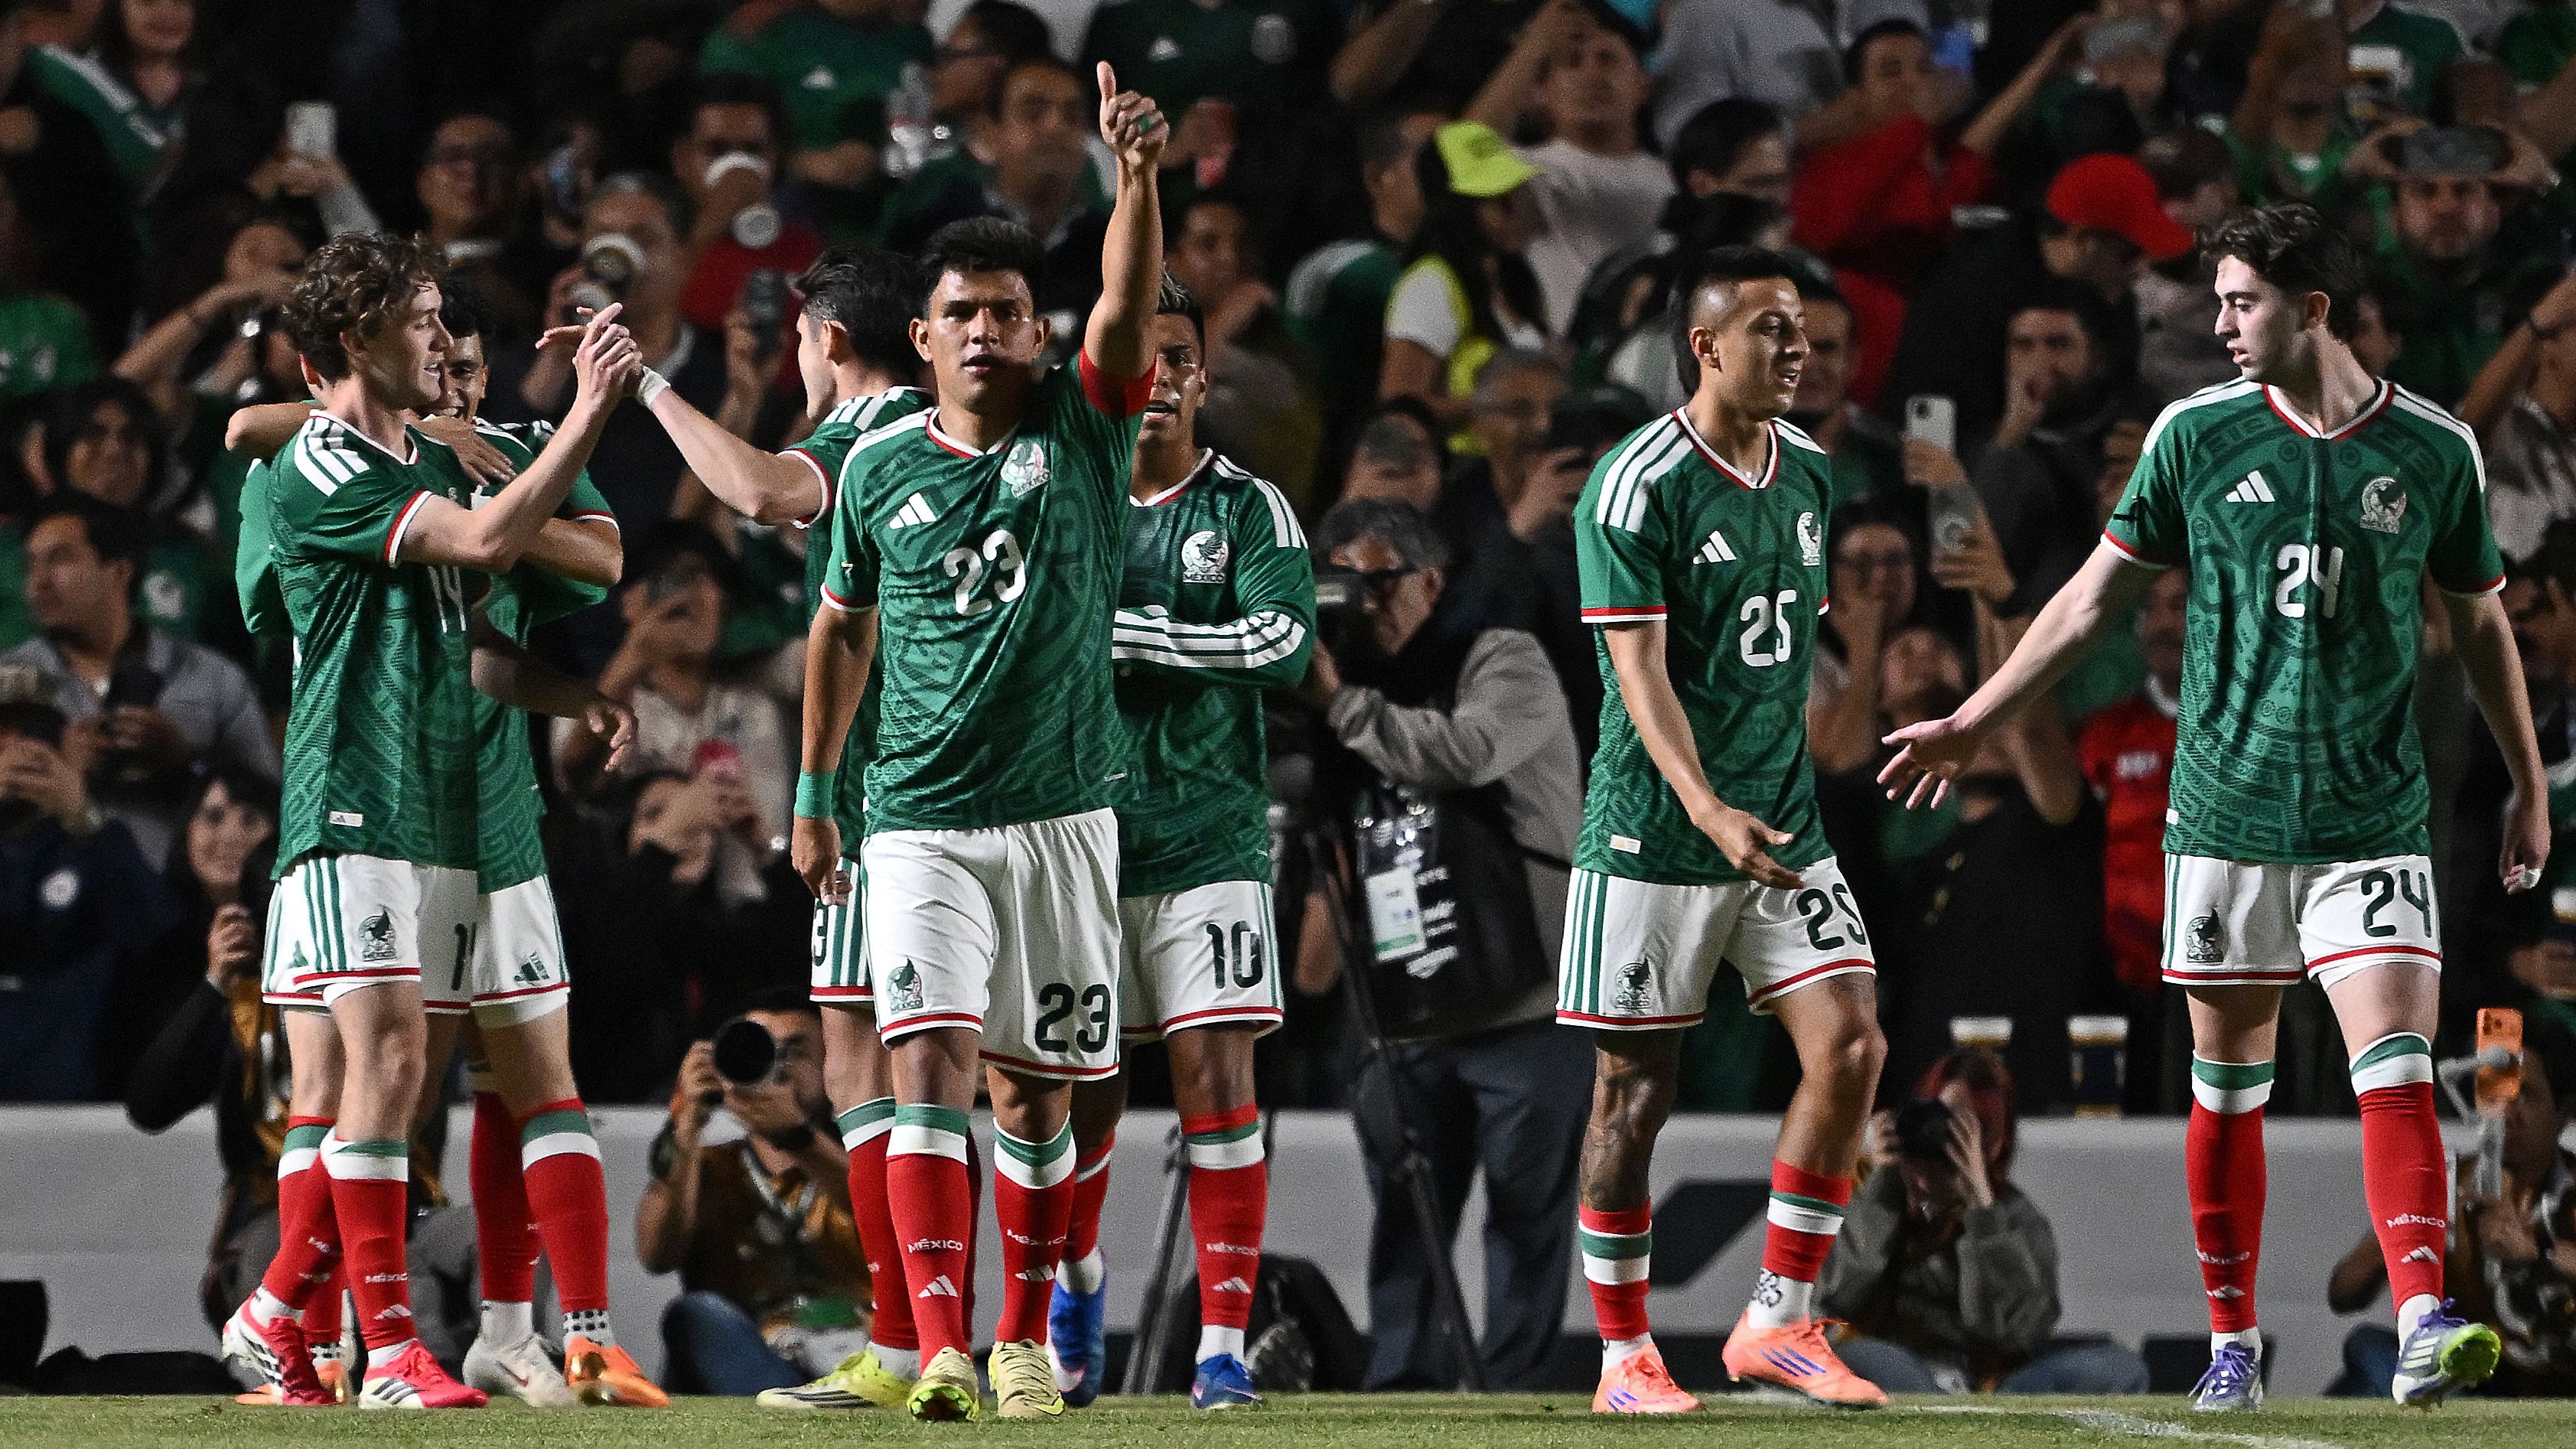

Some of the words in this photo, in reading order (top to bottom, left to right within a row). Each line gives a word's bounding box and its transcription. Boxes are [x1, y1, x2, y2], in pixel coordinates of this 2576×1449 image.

[943, 529, 1026, 616] 23
[2275, 543, 2343, 618] 24
[1740, 589, 1796, 667] 25
[1796, 883, 1867, 950] 25
[2361, 869, 2432, 938] 24
[451, 922, 477, 992] 1
[1206, 920, 1263, 989] 10
[1035, 982, 1110, 1053] 23
[907, 1238, 964, 1254] MÉXICO
[2386, 1213, 2446, 1228] MÉXICO
